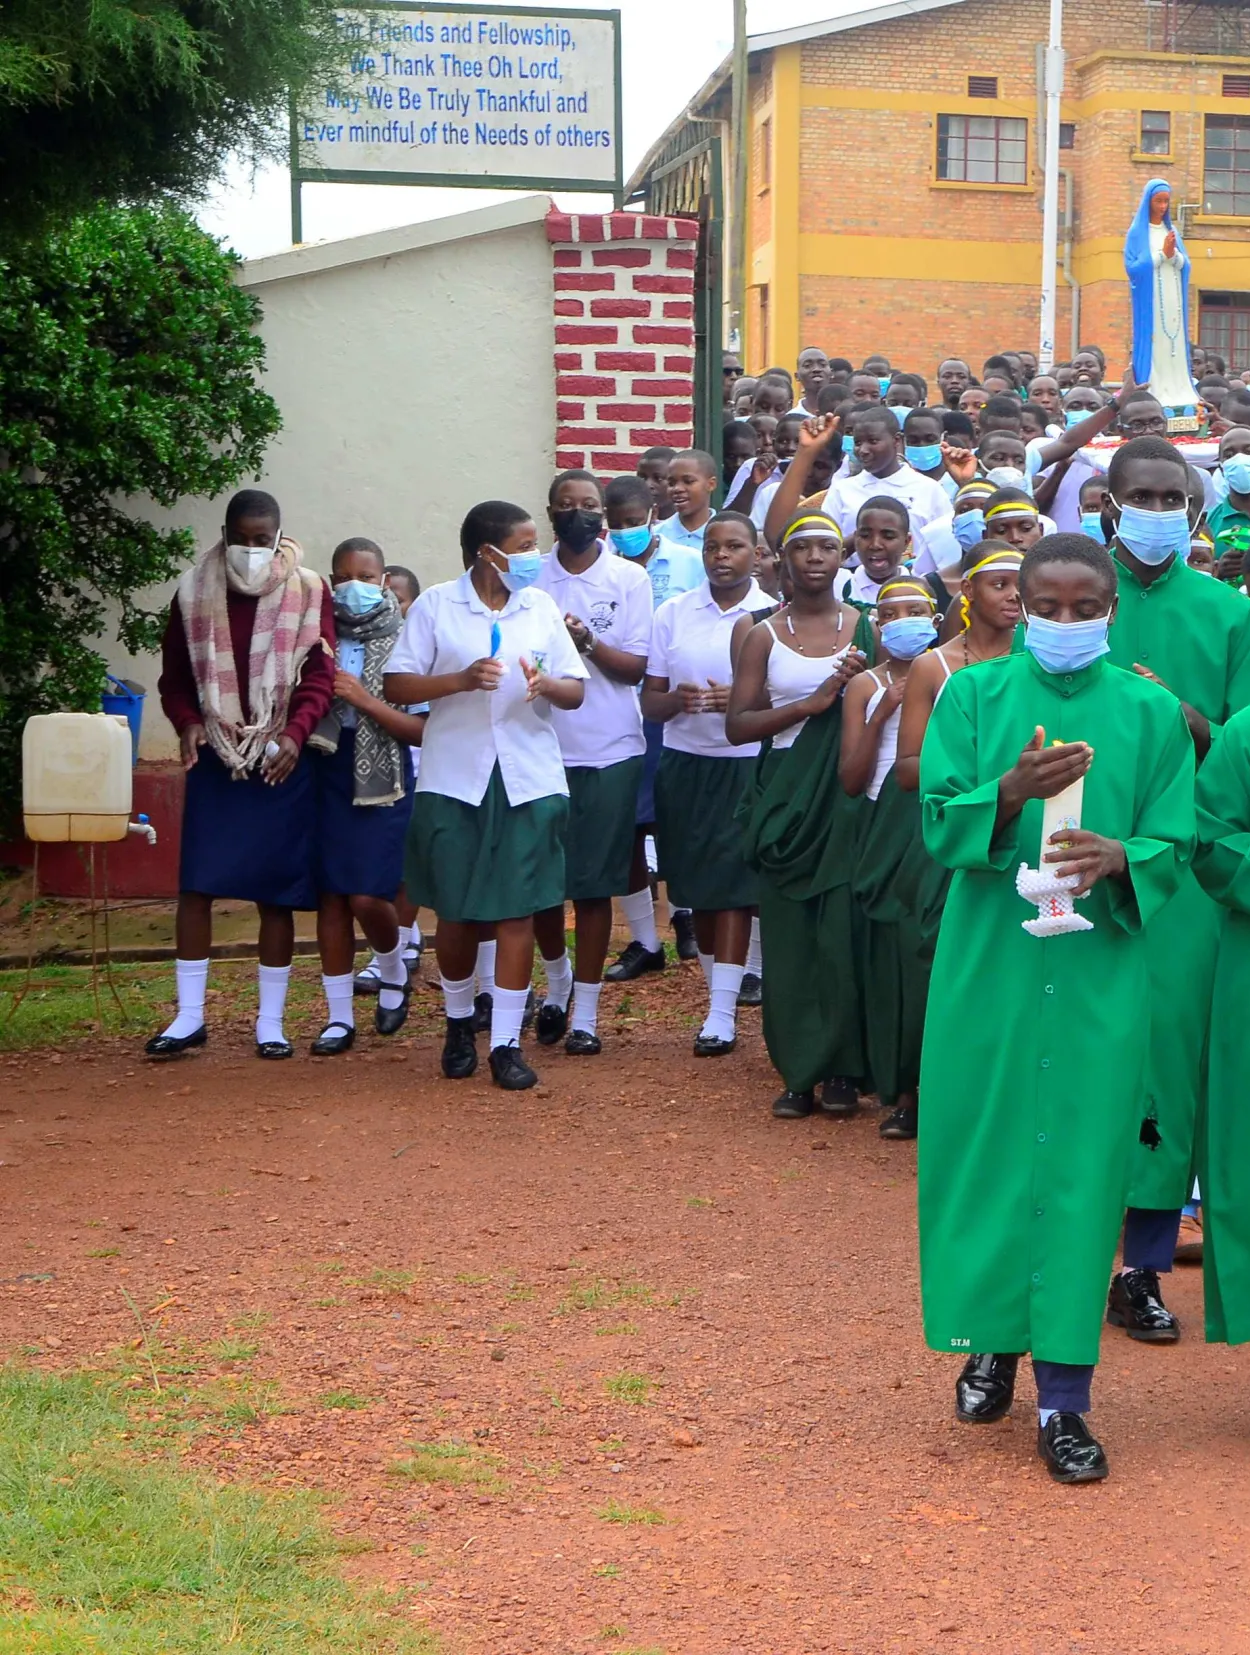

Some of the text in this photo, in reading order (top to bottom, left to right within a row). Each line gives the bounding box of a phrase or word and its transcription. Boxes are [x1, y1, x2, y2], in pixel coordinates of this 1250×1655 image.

[440, 20, 473, 43] and
[478, 22, 577, 51] Fellowship,
[350, 52, 564, 80] We Thank Thee Oh Lord,
[326, 86, 588, 117] May We Be Truly Thankful and
[304, 120, 611, 148] Ever mindful of the Needs of others
